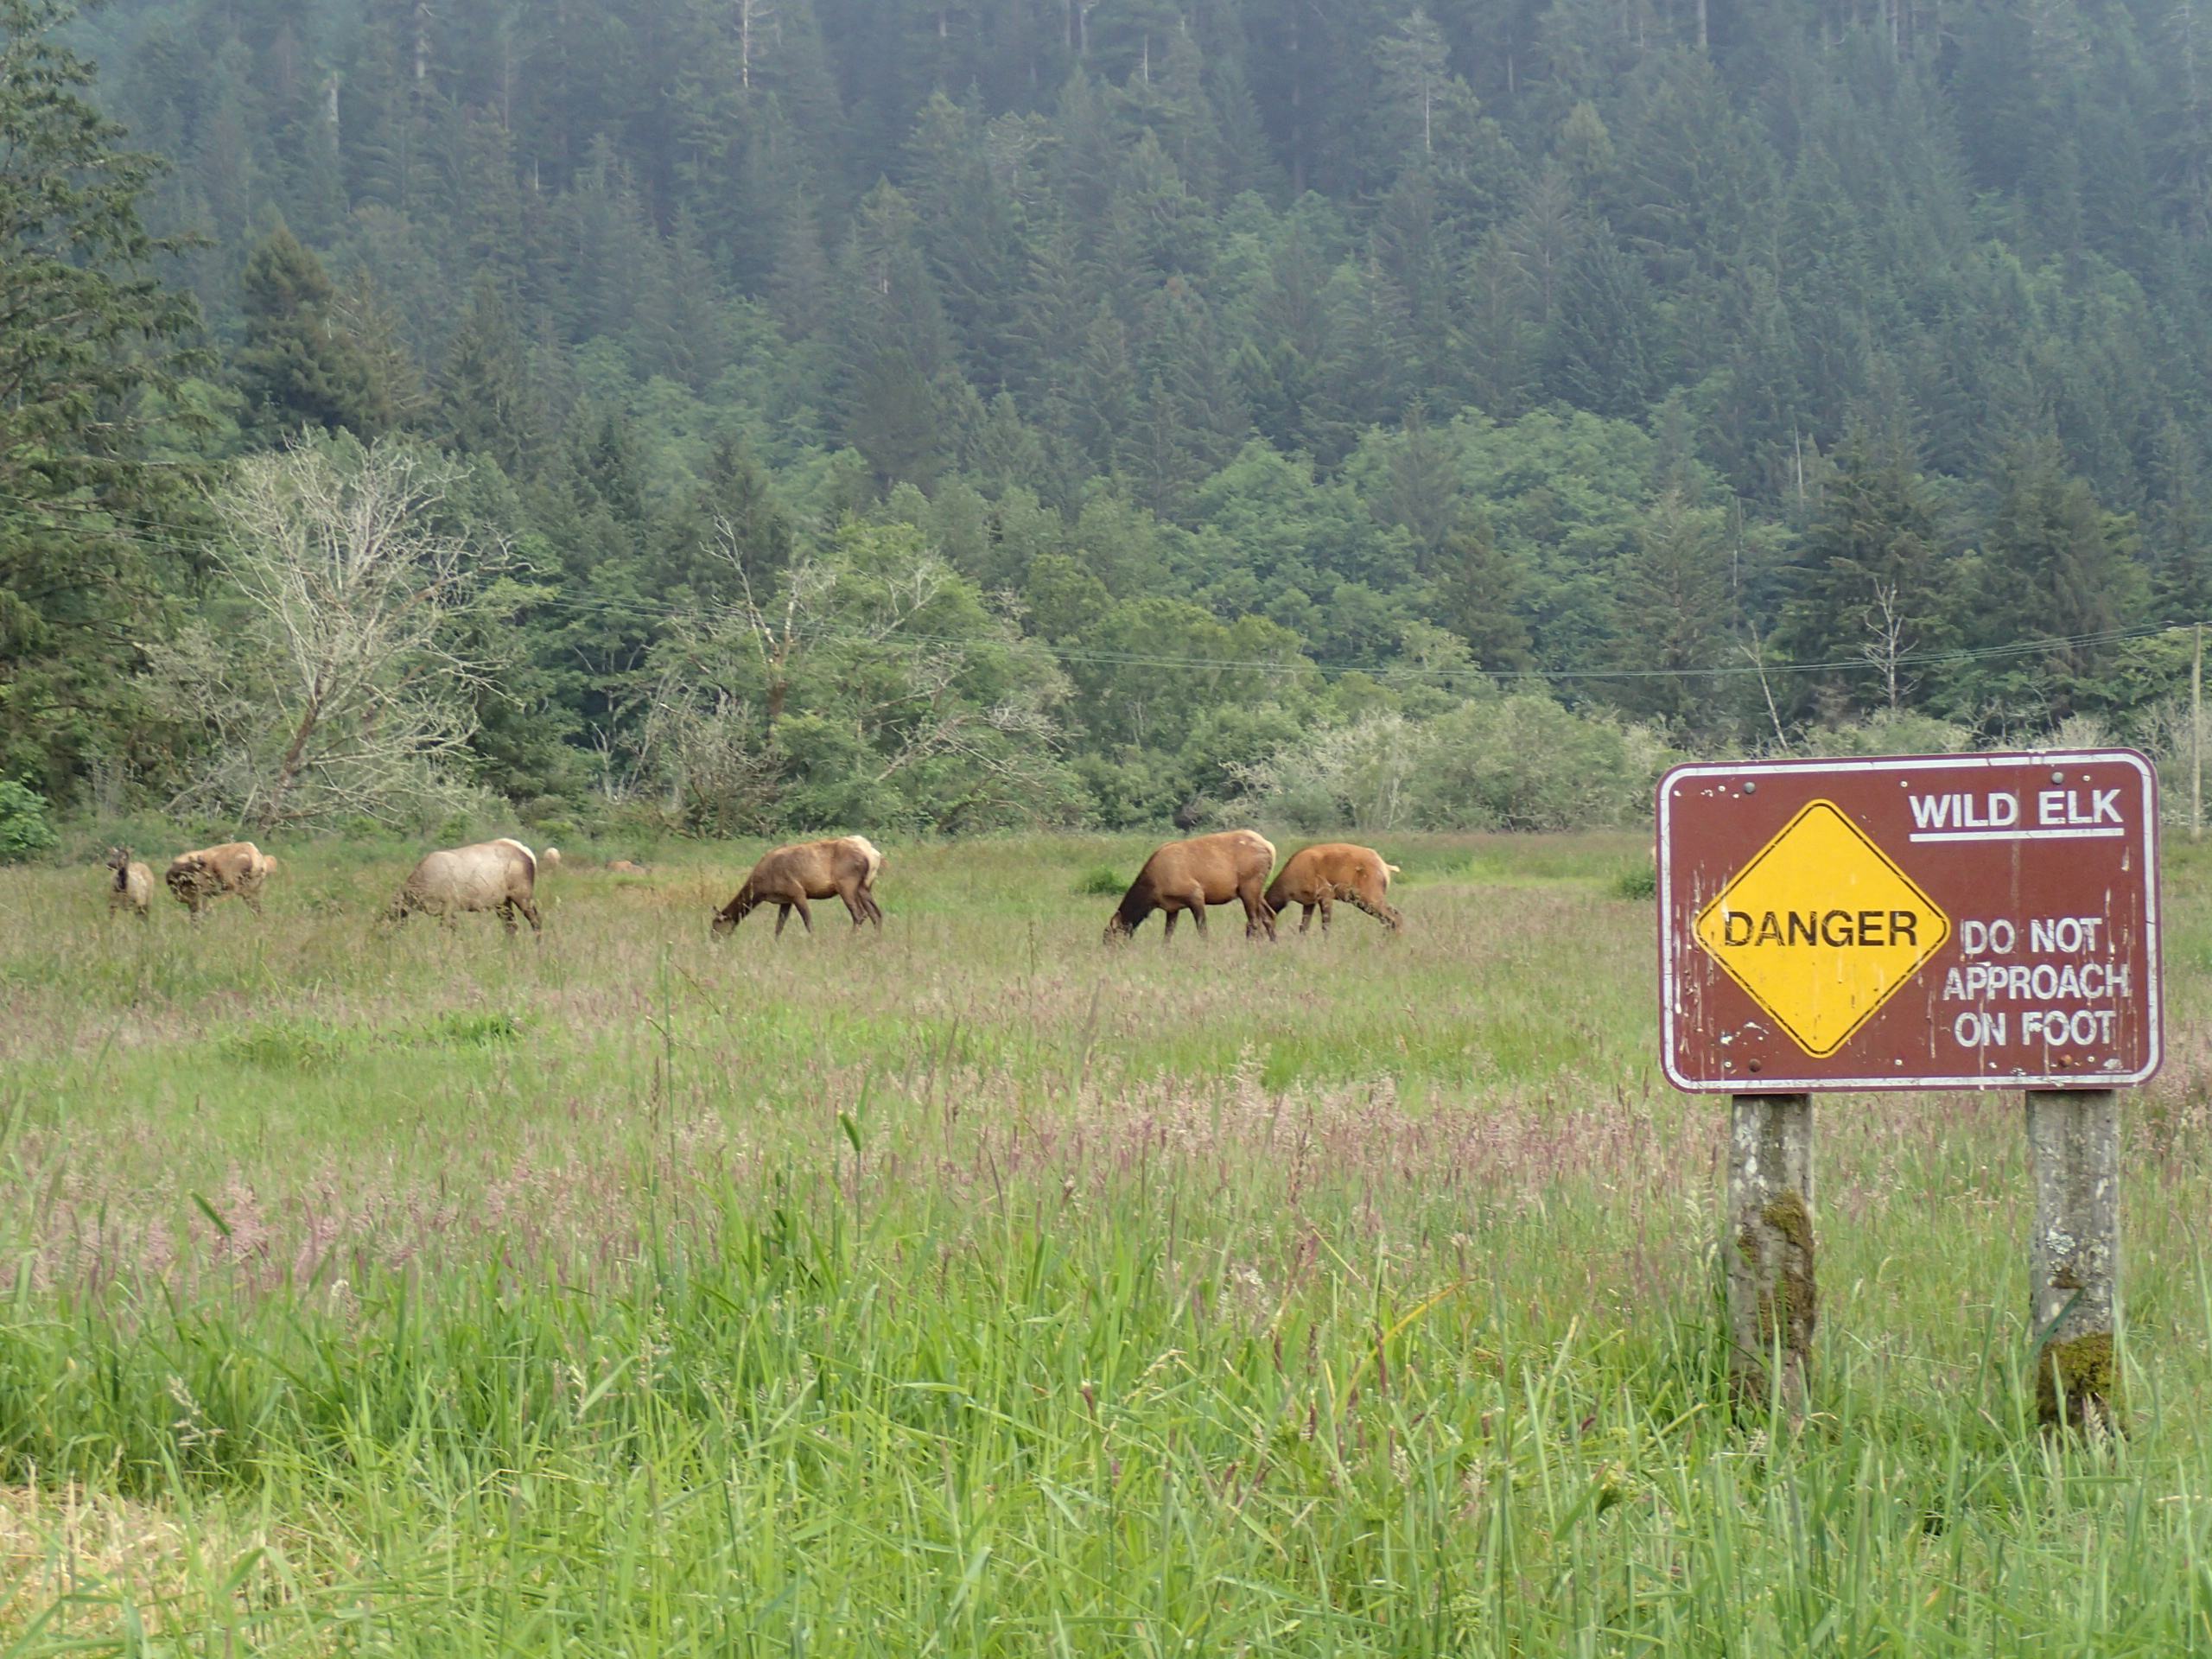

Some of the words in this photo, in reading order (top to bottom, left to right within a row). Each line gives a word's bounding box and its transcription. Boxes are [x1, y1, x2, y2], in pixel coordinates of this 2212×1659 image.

[1909, 793, 2018, 828] WILD
[2039, 789, 2123, 824] ELK
[1726, 910, 1917, 947] DANGER
[1963, 919, 2015, 955] DO
[2031, 917, 2102, 953] NOT
[1942, 963, 2131, 1001] APPROACH
[1955, 1012, 2005, 1047] ON
[2022, 1010, 2116, 1046] FOOT
